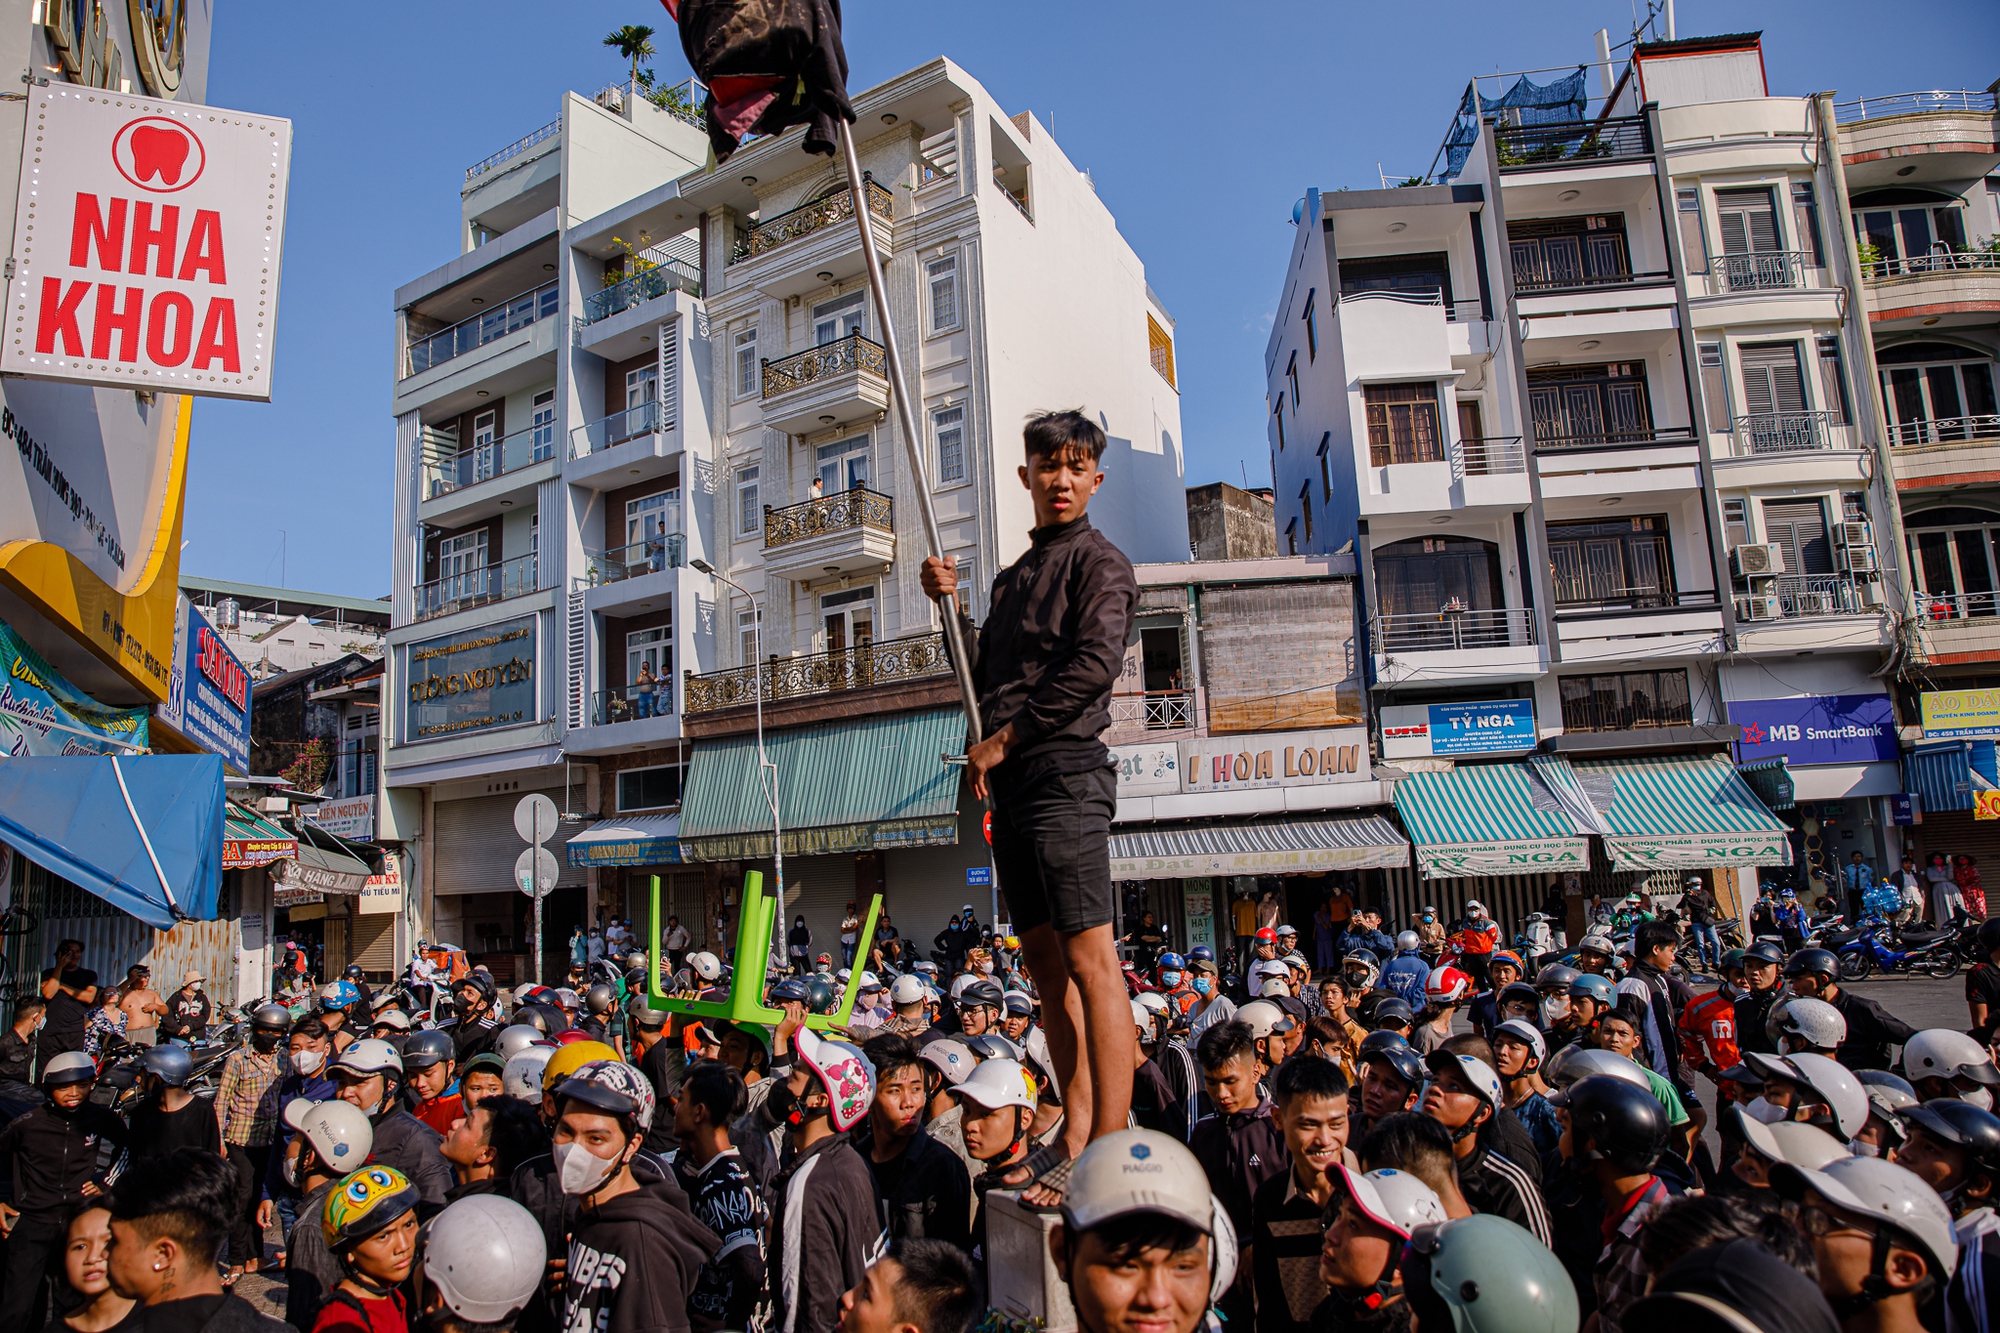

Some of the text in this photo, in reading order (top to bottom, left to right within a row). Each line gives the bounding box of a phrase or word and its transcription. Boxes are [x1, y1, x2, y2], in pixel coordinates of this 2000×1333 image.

[69, 191, 228, 285] NHA
[34, 276, 242, 374] KHOA
[410, 656, 533, 702] TƯỜNG NGUYÊN
[1928, 694, 1960, 711] ÁO
[1385, 724, 1428, 735] uni
[1448, 712, 1515, 730] TỶ NGA
[1770, 724, 1883, 742] MB SmartBank
[1955, 728, 1974, 736] TRẦN
[1284, 744, 1361, 778] LOAN
[337, 799, 369, 817] NGUYÊN
[588, 845, 616, 860] QUANG
[616, 840, 640, 858] NGÂN
[708, 839, 727, 857] HÀNG
[742, 833, 775, 855] LINH
[1439, 846, 1470, 854] PHÒNG
[1471, 844, 1496, 852] PHẨM
[1504, 843, 1528, 851] DỤNG
[1529, 843, 1542, 851] CỤ
[1543, 842, 1562, 850] HỌC
[1703, 846, 1783, 858] NGA
[1145, 858, 1194, 872] Đạt
[1233, 853, 1299, 867] KHOA
[1306, 850, 1369, 864] LOAN
[1506, 851, 1581, 864] NGA
[282, 860, 303, 880] CỬA
[304, 869, 336, 887] HÀNG
[930, 1045, 950, 1057] PIAGGIO
[319, 1120, 339, 1145] PIAGGIO
[1123, 1164, 1163, 1173] PIAGGIO
